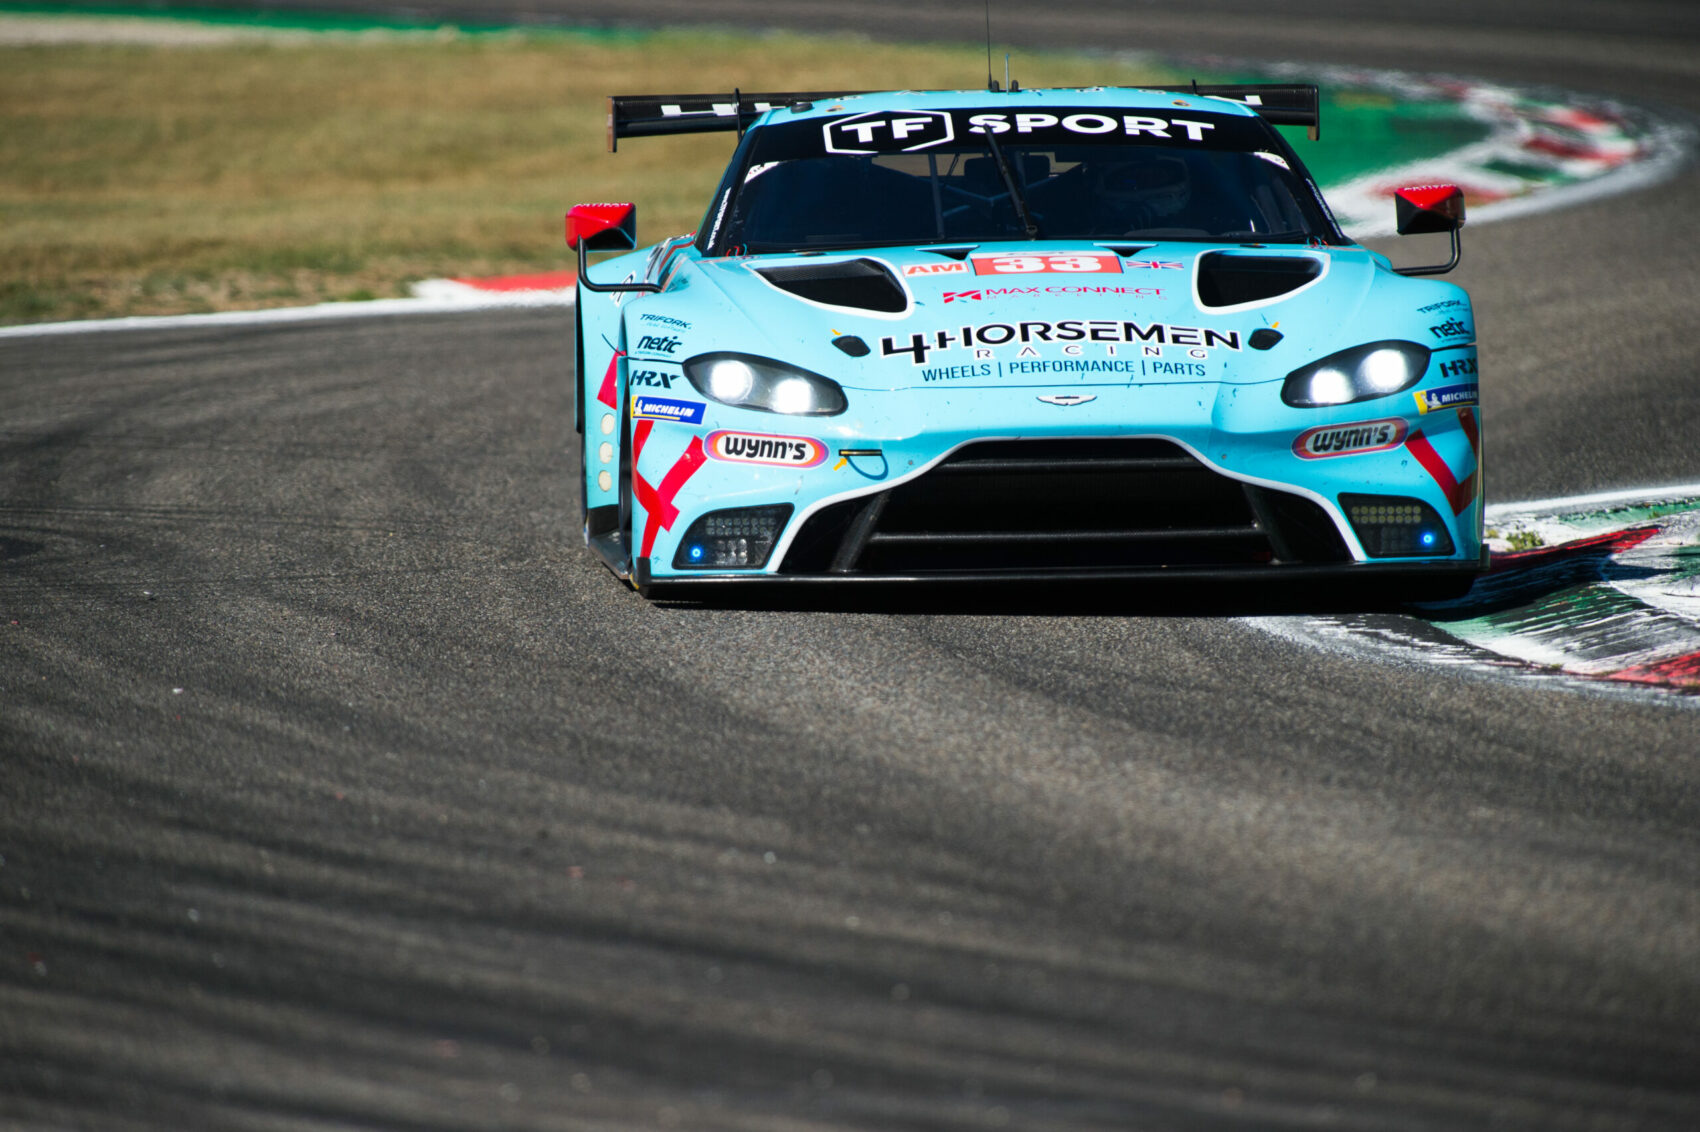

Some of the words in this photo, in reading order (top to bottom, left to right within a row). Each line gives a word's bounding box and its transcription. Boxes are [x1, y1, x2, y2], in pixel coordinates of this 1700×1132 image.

[841, 117, 932, 142] TF
[968, 113, 1215, 141] SPORT
[906, 263, 963, 275] AM
[992, 256, 1102, 272] 33
[985, 286, 1040, 295] MAX
[1045, 286, 1167, 295] CONNECT
[1429, 317, 1471, 338] netic
[637, 335, 683, 353] netic
[976, 345, 1206, 358] RACING
[922, 363, 991, 382] WHEELS
[1009, 360, 1134, 374] PERFORMANCE
[1153, 361, 1206, 376] PARTS
[1440, 358, 1478, 378] HRX
[630, 369, 680, 389] HRX
[642, 403, 695, 417] MICHELIN
